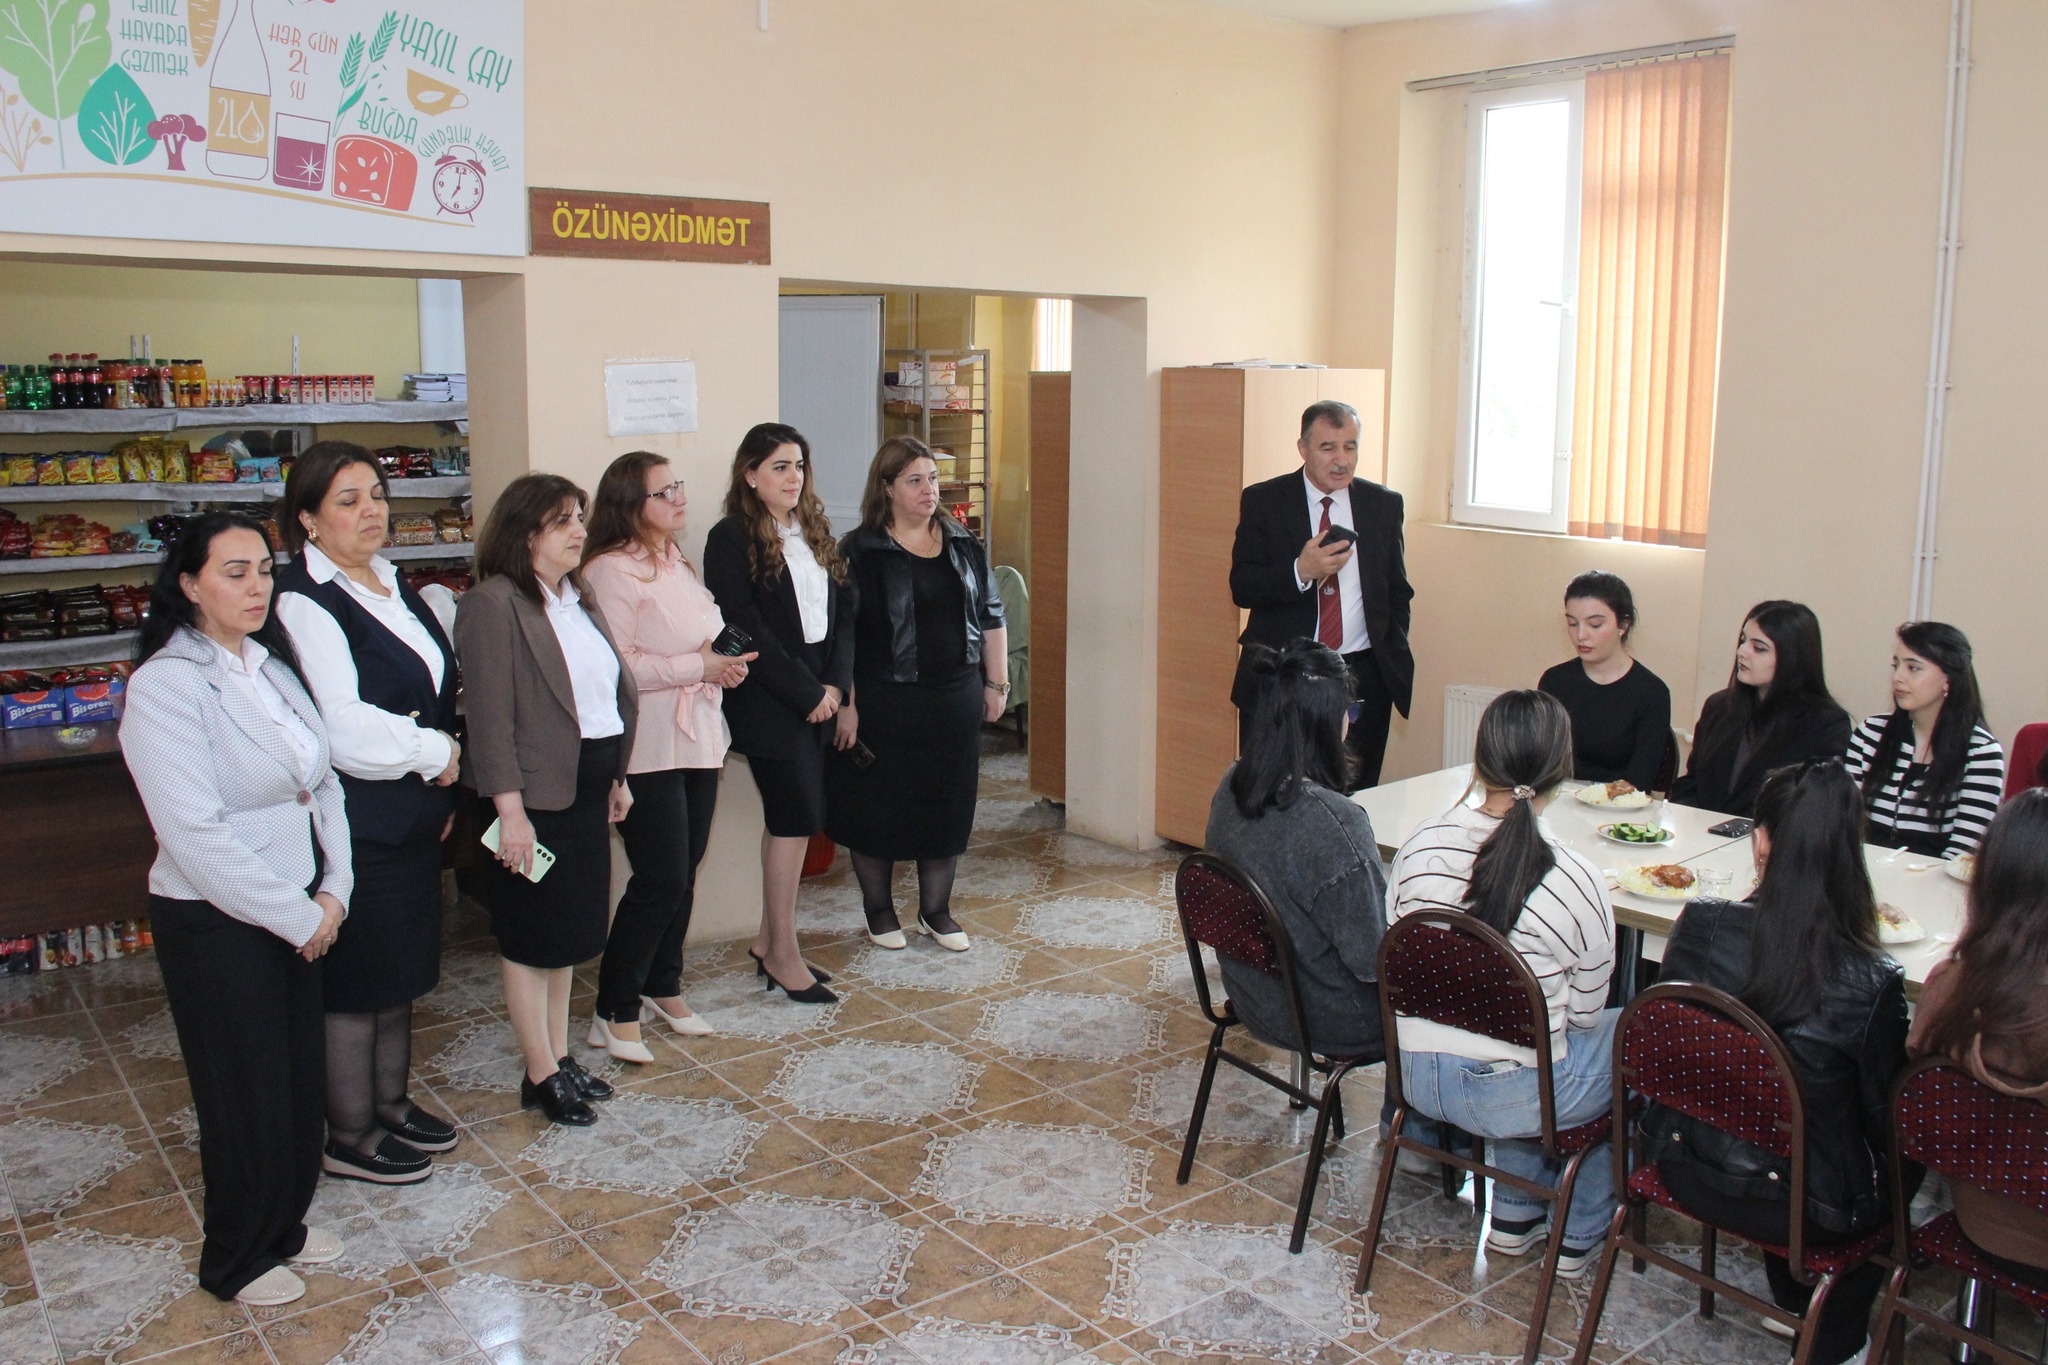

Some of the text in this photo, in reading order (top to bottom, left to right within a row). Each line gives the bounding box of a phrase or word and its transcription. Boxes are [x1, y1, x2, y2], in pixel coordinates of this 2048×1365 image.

[119, 18, 188, 46] HAVADA
[268, 23, 339, 56] HƏR GÜN
[120, 49, 189, 77] GƏZMƏK
[288, 50, 310, 76] 2L
[399, 13, 513, 93] YAŞIL ÇAY
[289, 79, 307, 101] SU
[214, 97, 239, 140] 2L
[357, 101, 419, 146] BUĞDA
[475, 132, 510, 173] HƏYAT
[438, 180, 445, 188] 9
[455, 166, 468, 176] 12
[473, 187, 479, 196] 3
[453, 201, 460, 210] 6
[552, 201, 751, 247] ÖZÜNƏXİDMƏT
[10, 702, 58, 721] Bisoreno
[72, 700, 112, 718] Bisoren
